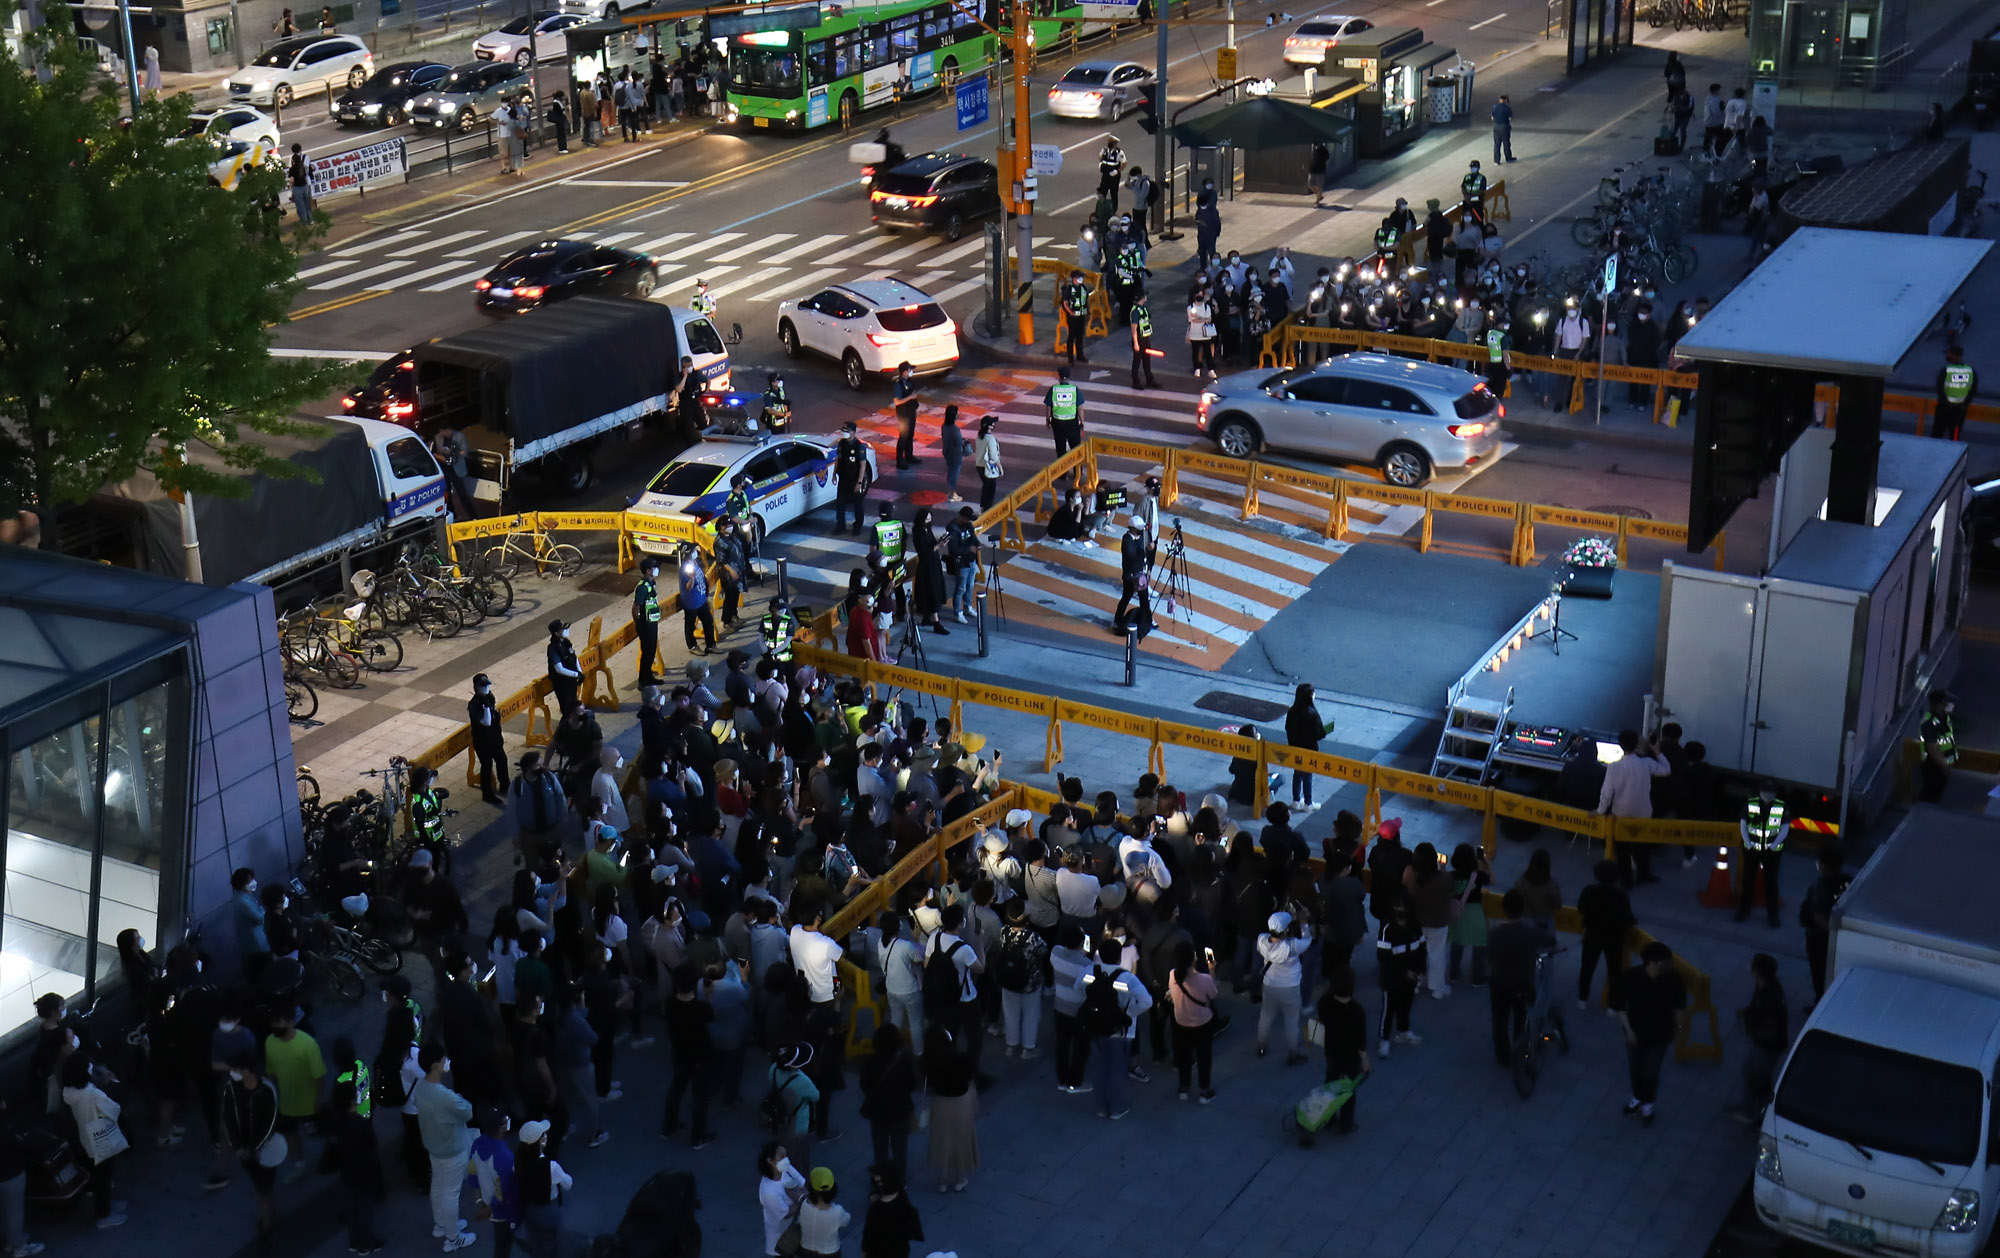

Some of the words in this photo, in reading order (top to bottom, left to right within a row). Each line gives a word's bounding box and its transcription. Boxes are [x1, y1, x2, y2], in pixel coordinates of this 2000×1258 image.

[940, 34, 954, 48] 3414
[957, 87, 988, 112] 택시정류장
[337, 164, 351, 176] 입은
[367, 164, 391, 179] 찾습니다
[1309, 330, 1337, 340] POLICE
[707, 362, 726, 377] POLICE
[1525, 357, 1553, 370] POLICE
[1603, 368, 1633, 380] POLICE
[1112, 444, 1142, 456] POLICE
[1144, 449, 1161, 459] LINE
[417, 485, 441, 502] POLICE
[1022, 482, 1037, 498] POLICE
[649, 499, 675, 507] POLICE
[765, 493, 788, 513] POLICE
[1455, 500, 1490, 512] POLICE
[1492, 504, 1513, 515] LINE
[475, 522, 507, 533] POLICE
[584, 517, 616, 526] 넘지마시오
[643, 520, 671, 532] POLICE
[673, 525, 689, 535] LINE
[582, 653, 597, 667] LINE
[890, 671, 925, 687] POLICE
[927, 680, 948, 692] LINE
[499, 700, 520, 718] OLICE
[521, 690, 536, 705] LINE
[984, 691, 1021, 706] POLICE
[1023, 698, 1046, 711] LINE
[1083, 711, 1120, 728] POLICE
[1123, 721, 1146, 733] LINE
[1186, 732, 1225, 749] POLICE
[1228, 741, 1252, 754] LINE
[1406, 780, 1415, 790] 이
[994, 799, 1011, 815] LINE
[1918, 950, 1936, 961] KIA
[1939, 955, 1985, 972] MOTORS
